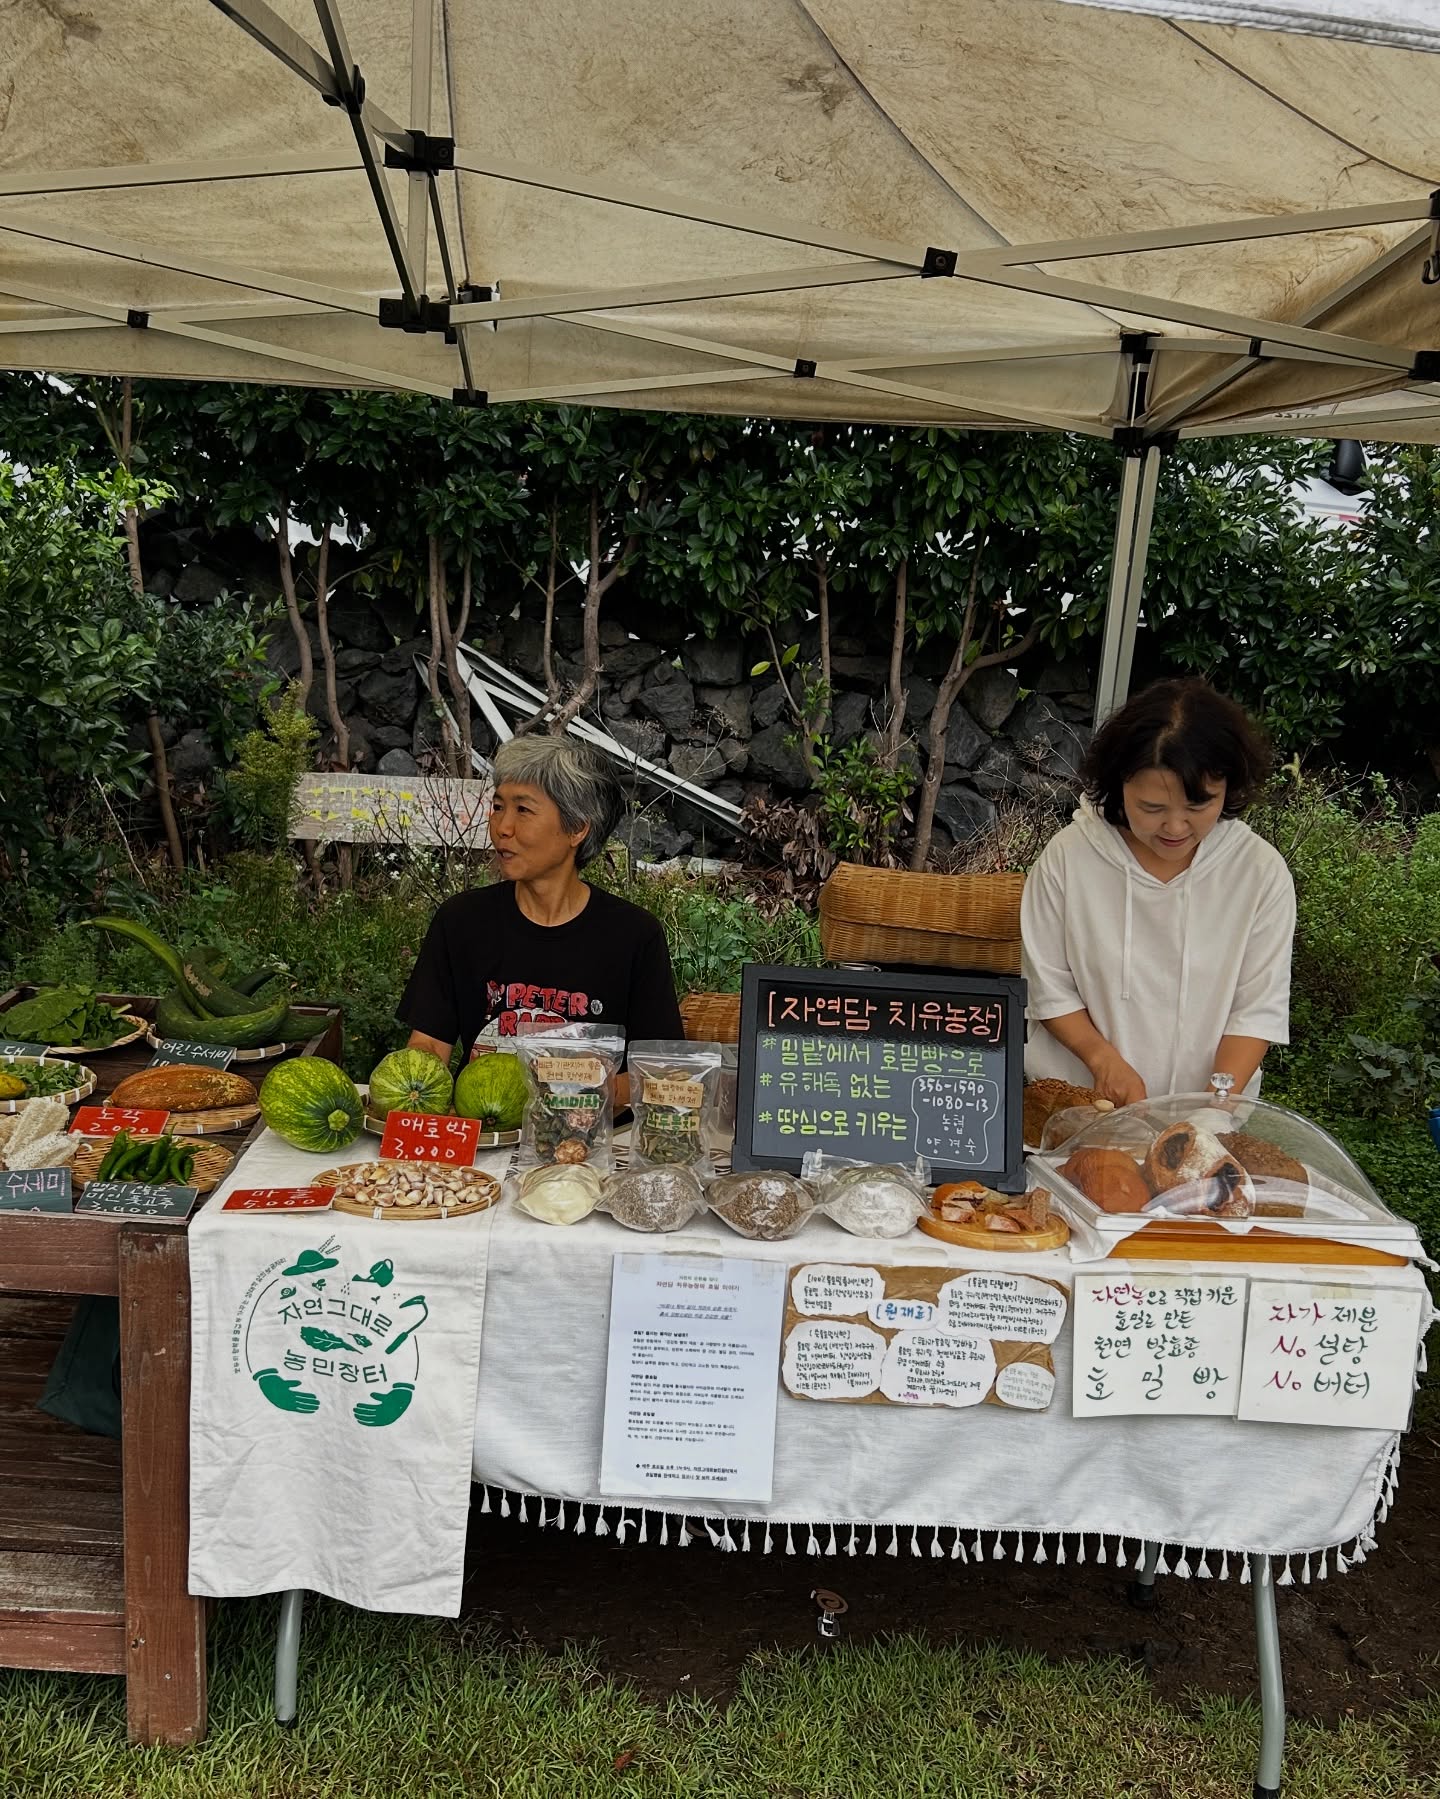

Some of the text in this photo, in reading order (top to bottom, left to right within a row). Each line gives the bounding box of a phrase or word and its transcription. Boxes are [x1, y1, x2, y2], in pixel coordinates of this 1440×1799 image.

[507, 983, 588, 1016] PETER
[881, 1043, 986, 1077] 호밀빵으로
[850, 1074, 891, 1099] 없는
[856, 1112, 908, 1141] 키우는
[941, 1114, 965, 1135] 농협
[5, 1170, 66, 1199] 수세미
[1092, 1283, 1238, 1306] 자연농으로 직접 키운
[278, 1297, 392, 1338] 자연그대로
[1115, 1309, 1196, 1331] 호밀로 만든
[1268, 1303, 1378, 1333] 자가 제분
[1094, 1334, 1200, 1360] 천연 발효종
[1314, 1334, 1369, 1366] 설탕
[283, 1349, 387, 1383] 농민장터
[1313, 1371, 1371, 1399] 버터
